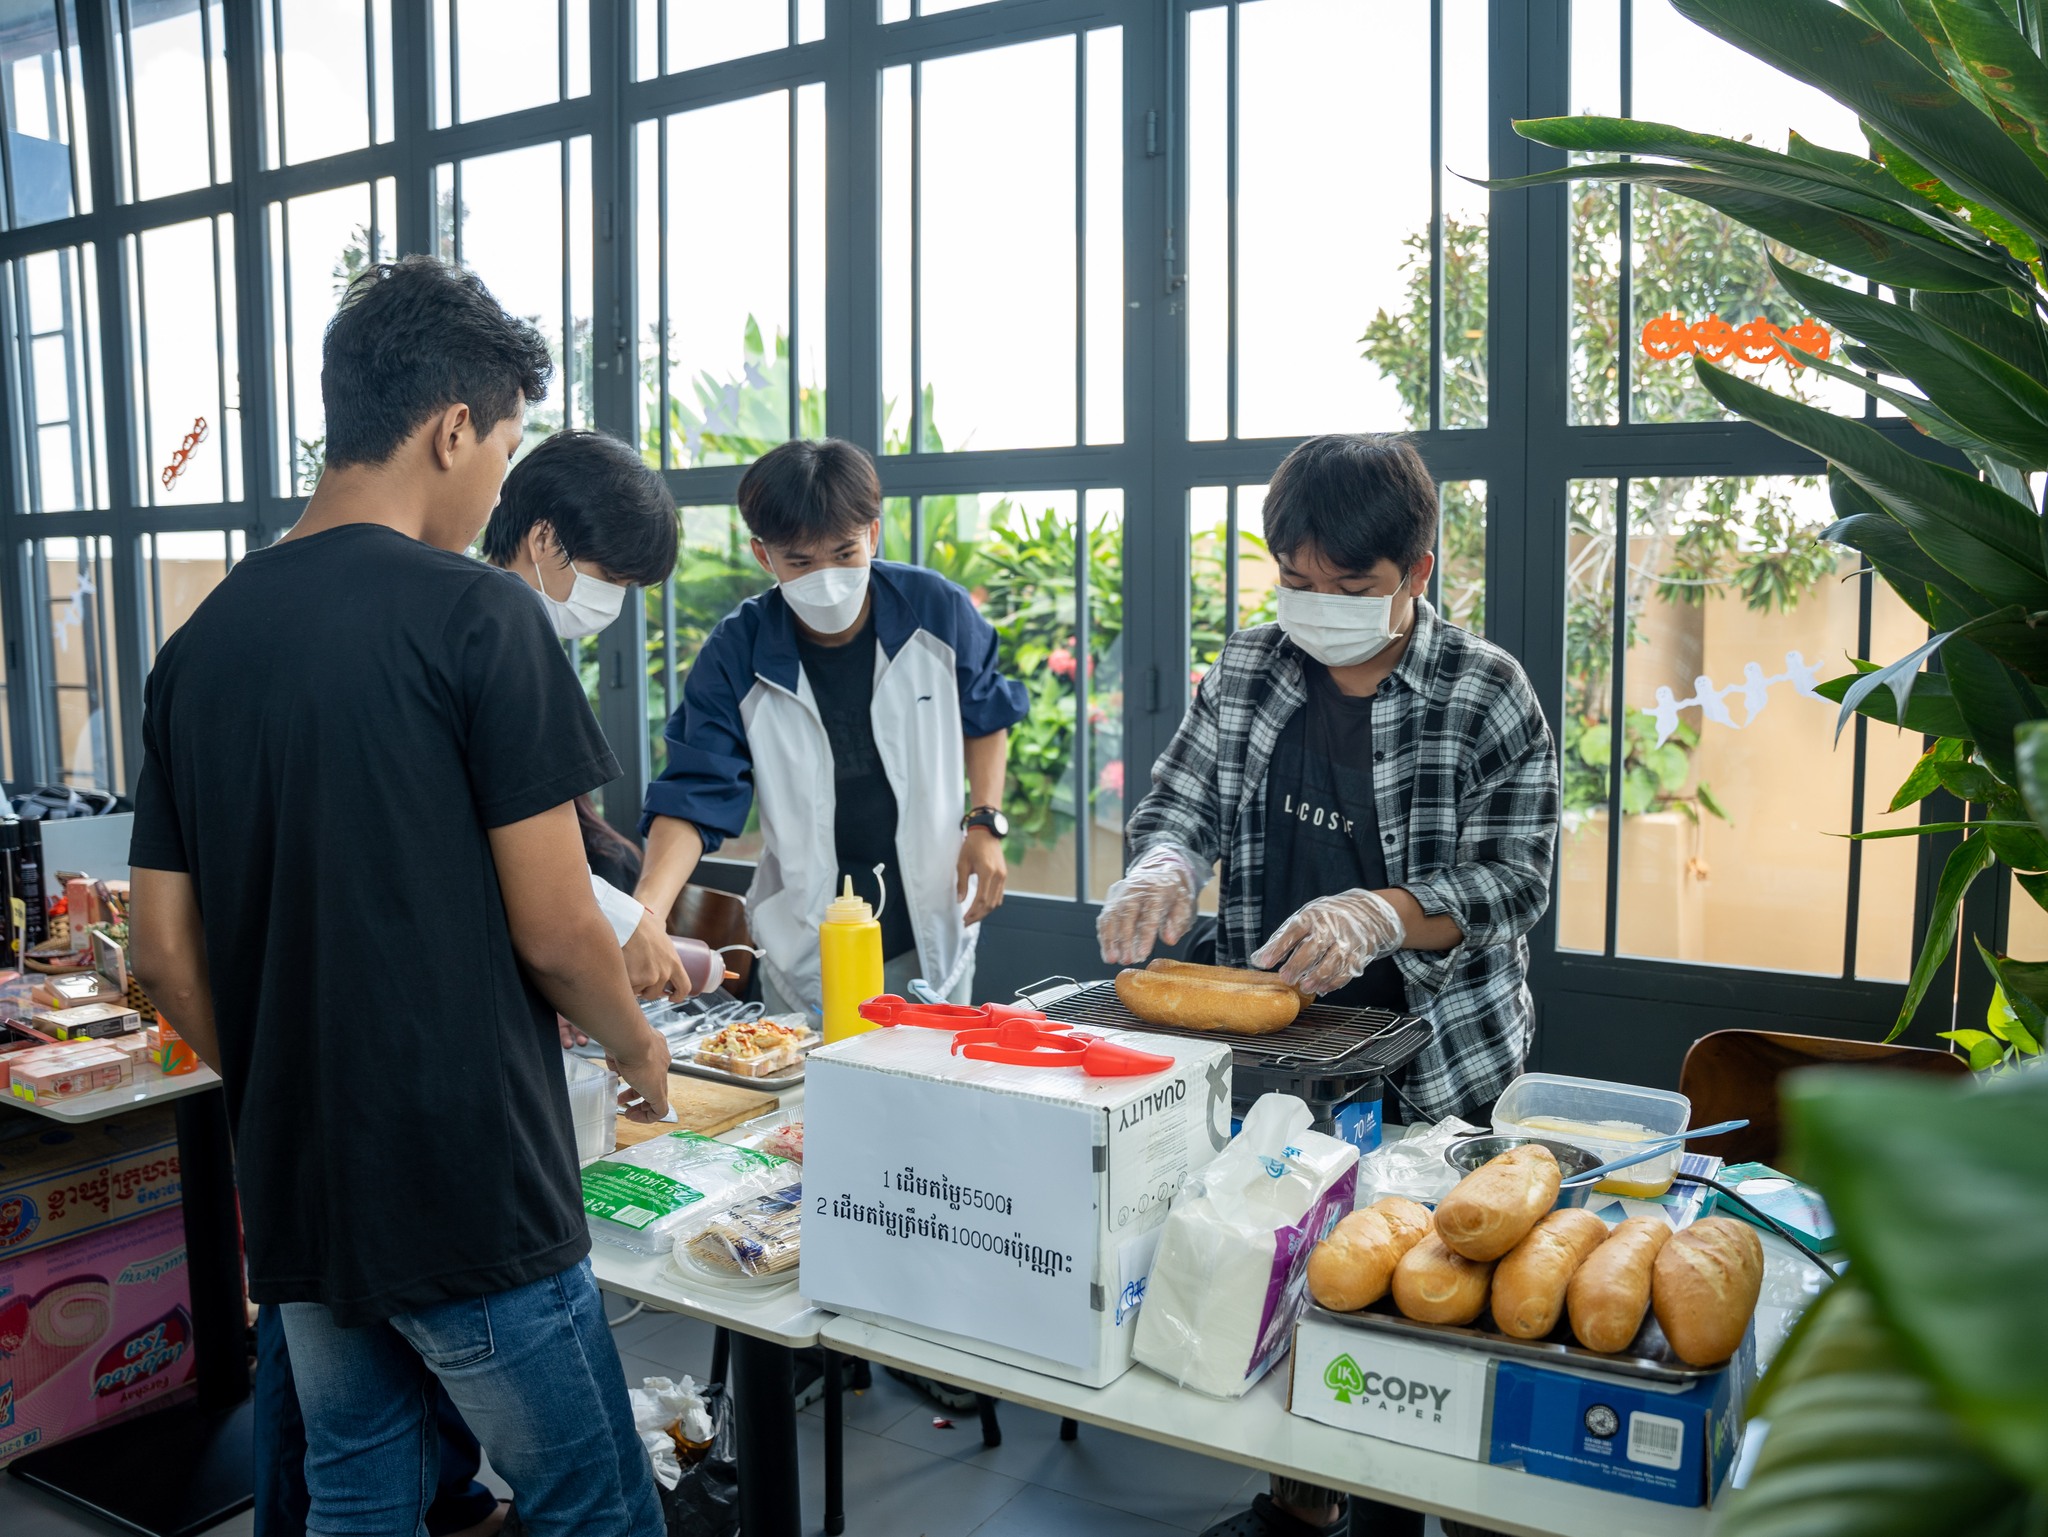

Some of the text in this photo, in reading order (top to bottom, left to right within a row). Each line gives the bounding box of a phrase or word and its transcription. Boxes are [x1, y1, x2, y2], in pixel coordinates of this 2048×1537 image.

[1118, 1079, 1186, 1133] QUALITY
[1353, 1119, 1365, 1143] 70
[883, 1170, 890, 1188] 1
[816, 1197, 828, 1215] 2
[1336, 1364, 1452, 1411] IK COPY
[1361, 1396, 1442, 1424] PAPER
